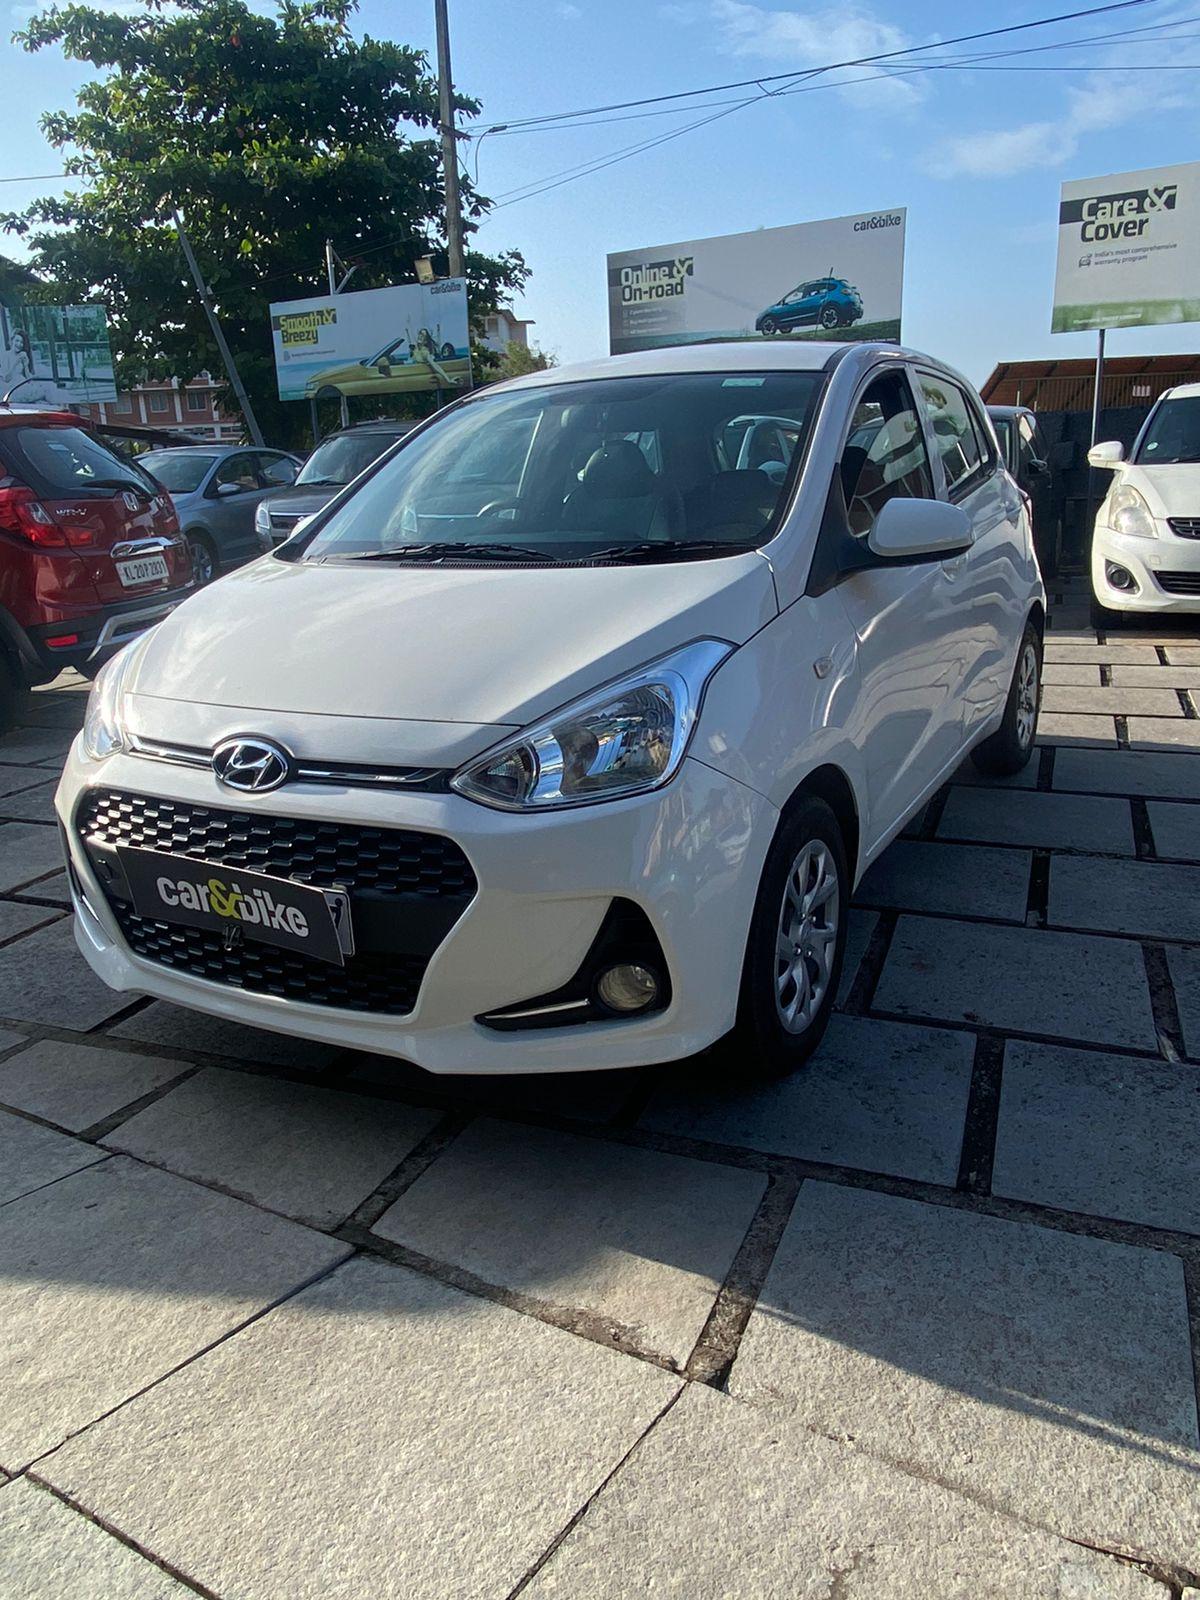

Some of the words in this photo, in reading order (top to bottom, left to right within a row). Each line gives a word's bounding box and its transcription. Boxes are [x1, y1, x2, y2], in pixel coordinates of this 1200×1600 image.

[1081, 198, 1139, 221] Care
[853, 214, 902, 232] car&bike
[1080, 217, 1150, 243] Cover
[1121, 254, 1148, 264] program
[620, 263, 670, 287] Online
[621, 275, 684, 302] On-road
[279, 310, 321, 331] Smooth
[281, 328, 319, 345] Breezy
[156, 876, 310, 938] car&bike
